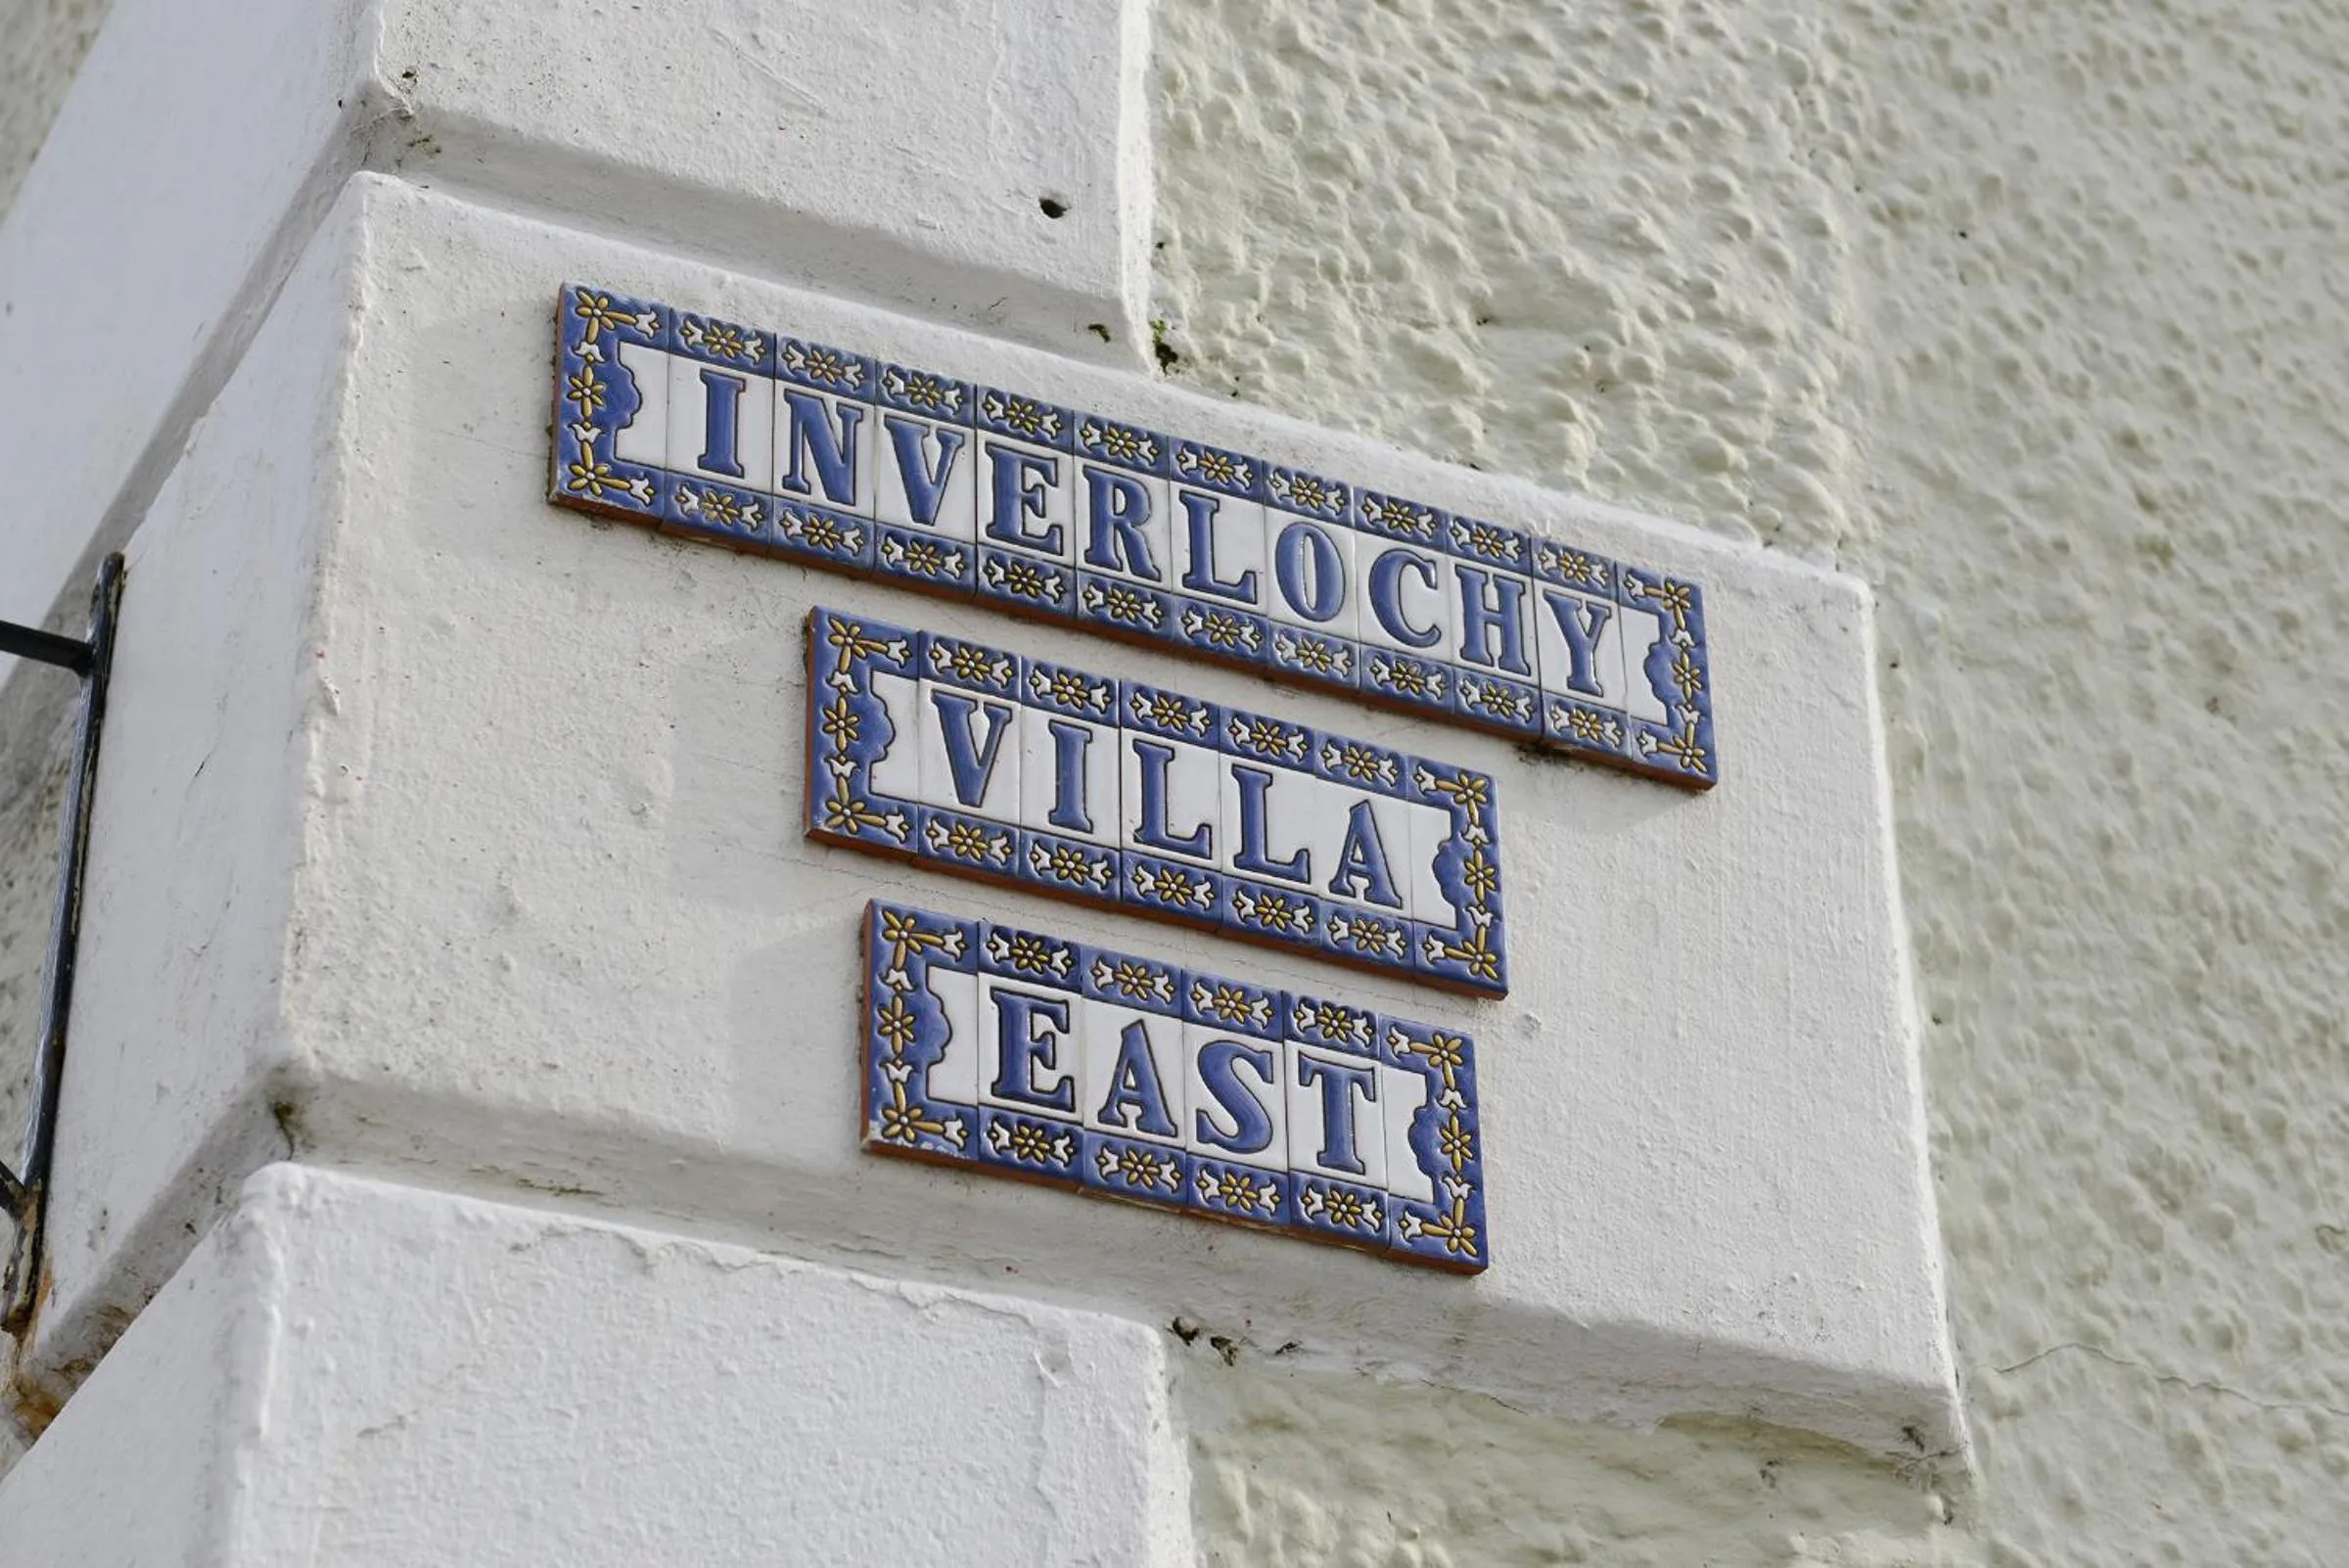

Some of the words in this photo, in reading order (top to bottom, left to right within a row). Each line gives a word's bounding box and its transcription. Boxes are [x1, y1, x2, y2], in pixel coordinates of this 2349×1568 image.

[698, 369, 1613, 697] INVERLOCHY
[931, 688, 1402, 909] VILLA
[990, 987, 1377, 1176] EAST
